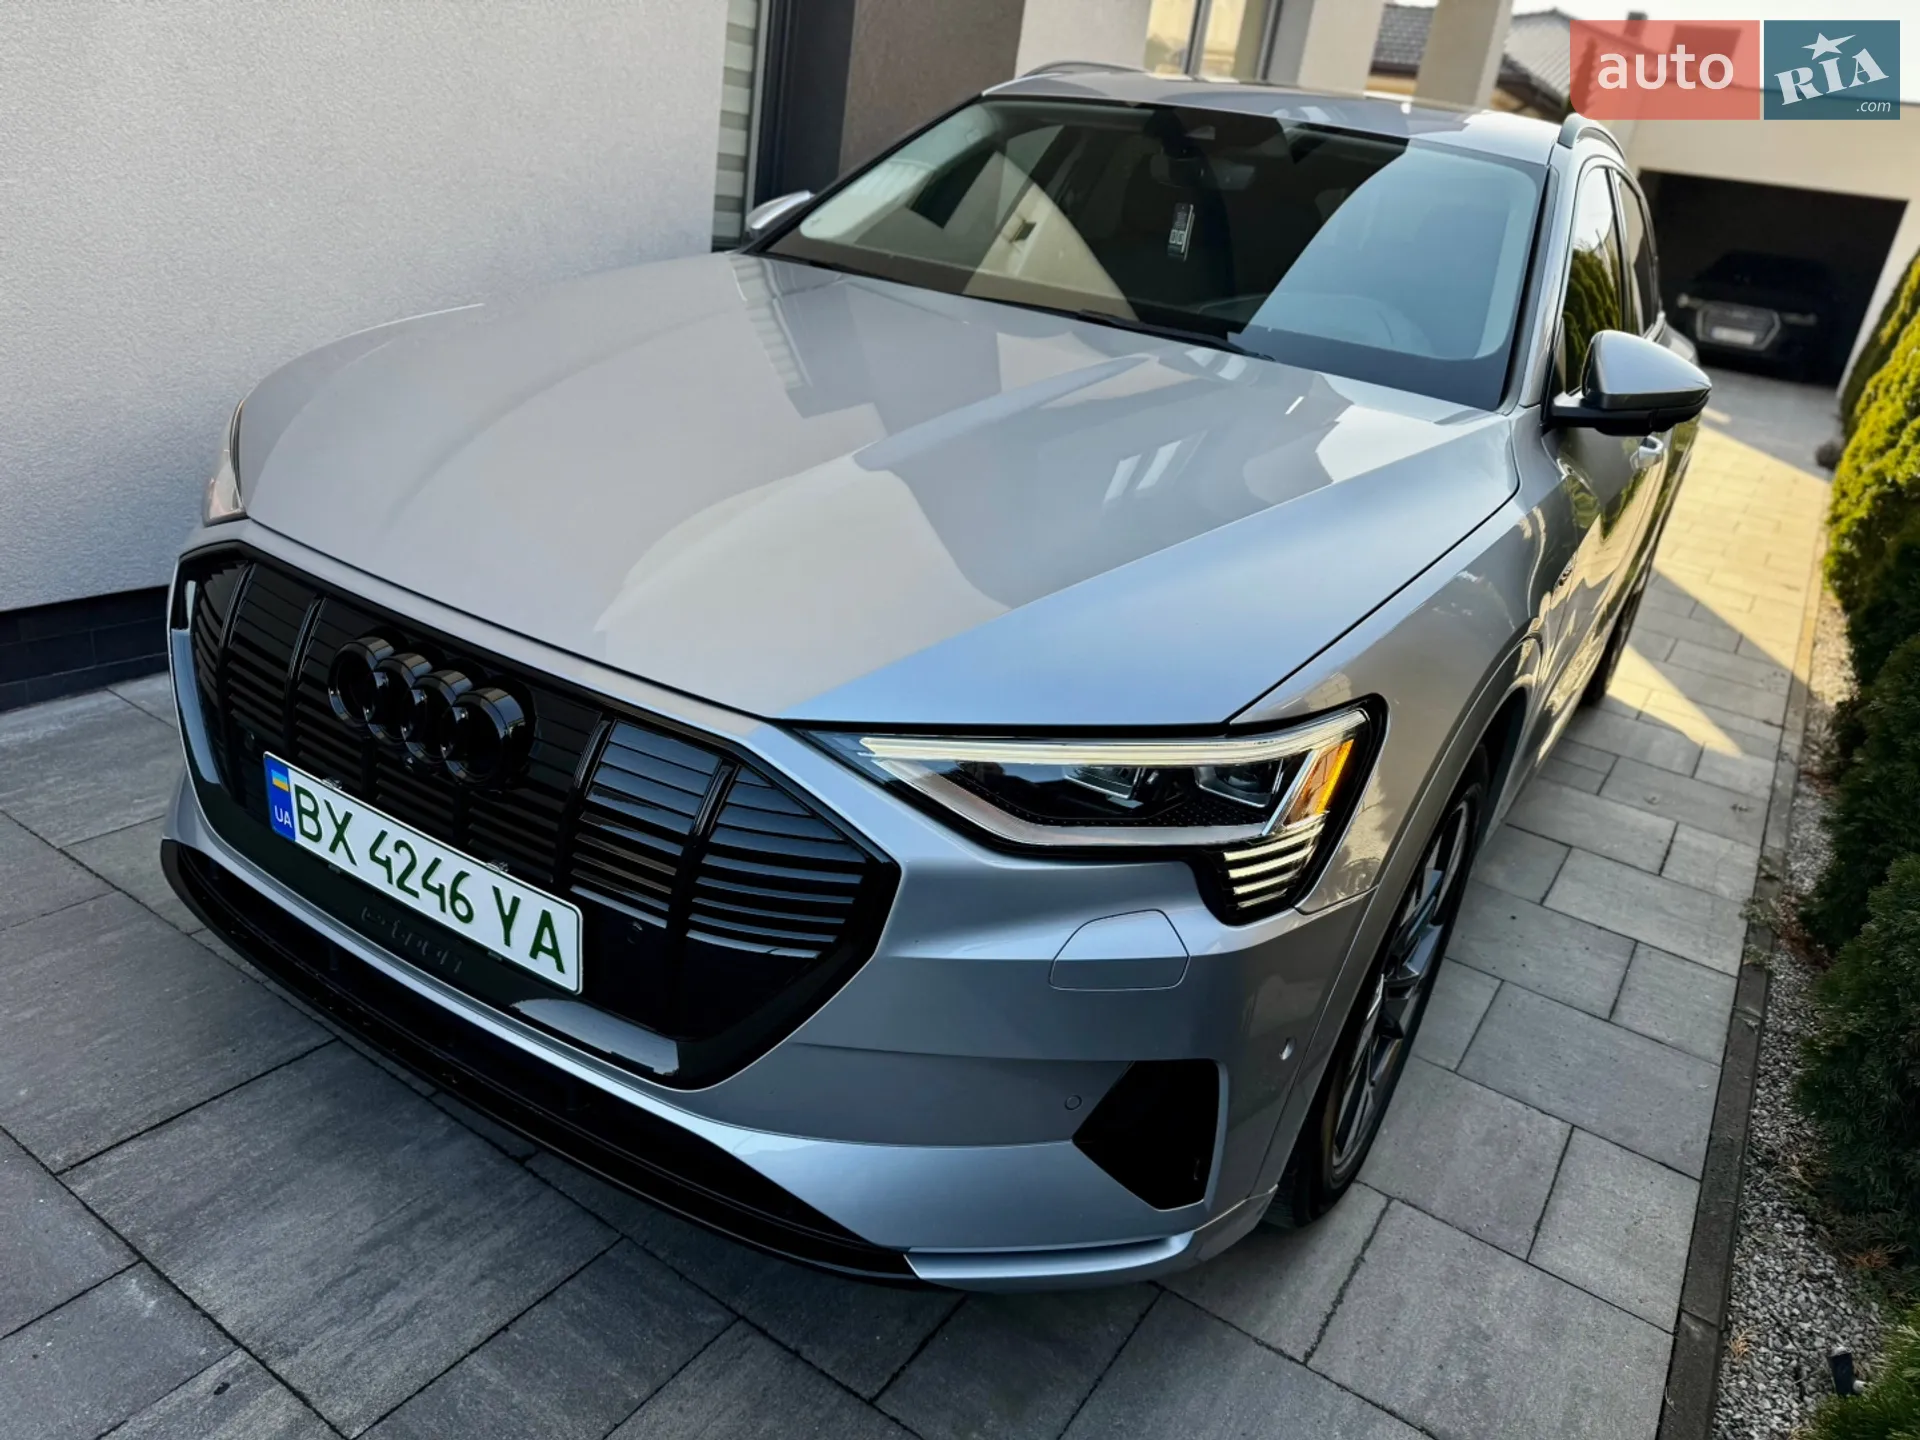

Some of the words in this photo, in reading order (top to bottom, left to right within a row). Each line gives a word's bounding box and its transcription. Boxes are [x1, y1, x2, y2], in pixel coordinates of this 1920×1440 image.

[274, 804, 293, 829] UA
[294, 783, 358, 867] BX
[369, 829, 475, 925] 4246
[491, 884, 566, 975] YA
